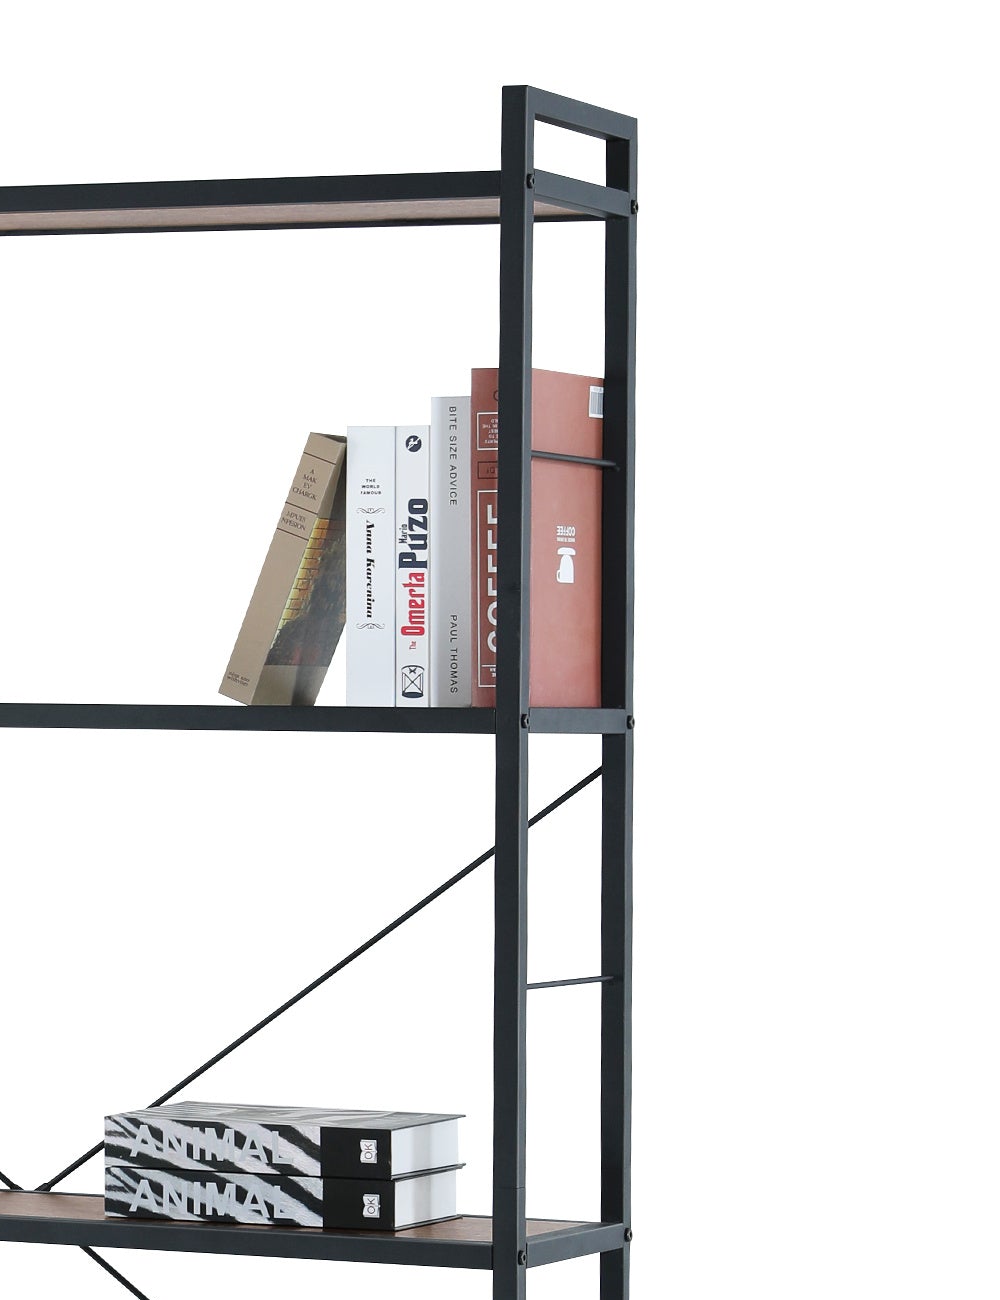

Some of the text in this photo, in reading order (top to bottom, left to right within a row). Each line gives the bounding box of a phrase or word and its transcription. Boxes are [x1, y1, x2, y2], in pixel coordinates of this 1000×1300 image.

[449, 406, 457, 506] BITE SIZE ADVICE
[398, 523, 408, 544] Mario
[398, 498, 428, 569] Puzo
[556, 525, 576, 537] COFFEE
[366, 520, 375, 618] Anna Karenina
[400, 572, 425, 636] Omerta
[450, 614, 458, 694] PAUL THOMAS
[128, 1124, 295, 1166] ANIMAL
[128, 1178, 296, 1220] ANIMAL
